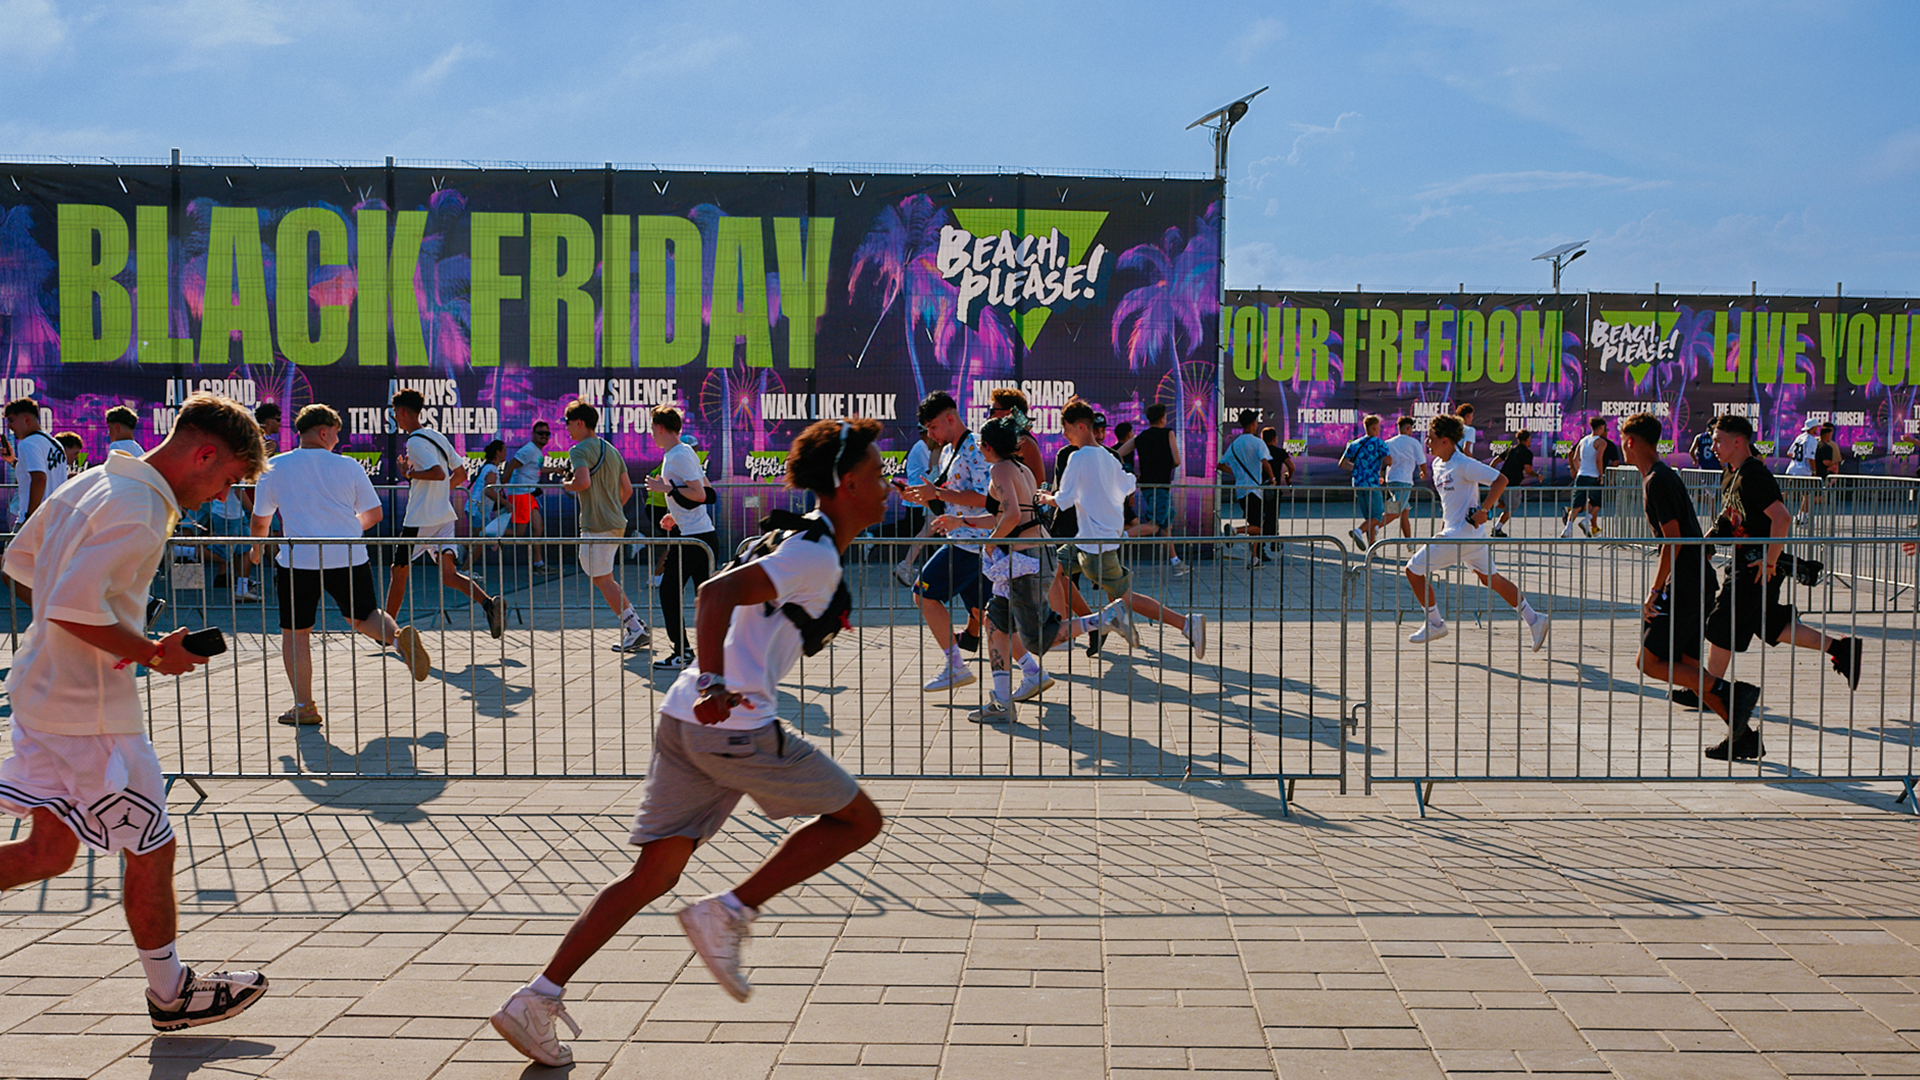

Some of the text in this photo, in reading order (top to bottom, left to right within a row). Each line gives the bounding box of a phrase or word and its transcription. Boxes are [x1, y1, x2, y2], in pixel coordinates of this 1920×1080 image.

[58, 204, 834, 369] BLACK FRIDAY
[956, 243, 1106, 324] PLEASE!
[1343, 308, 1563, 384] FREEDOM
[1600, 329, 1680, 372] PLEASE!
[1712, 311, 1809, 384] LIVE
[579, 379, 677, 406] MY SILENCE
[1021, 380, 1075, 406] SHARP
[760, 393, 897, 420] WALK LIKE I TALK
[1298, 409, 1315, 423] I'VE
[1316, 409, 1339, 423] BEEN
[1413, 402, 1450, 416] MAKE IT
[1505, 402, 1563, 419] CLEAN SLATE,
[1601, 401, 1669, 416] RESPECT EARNS
[1713, 403, 1760, 417] THE VISION
[1831, 411, 1865, 426] CHOSEN
[348, 407, 498, 434] TEN SPS AHEAD
[1505, 417, 1562, 432] FULL HUNGER
[1703, 445, 1713, 459] 6
